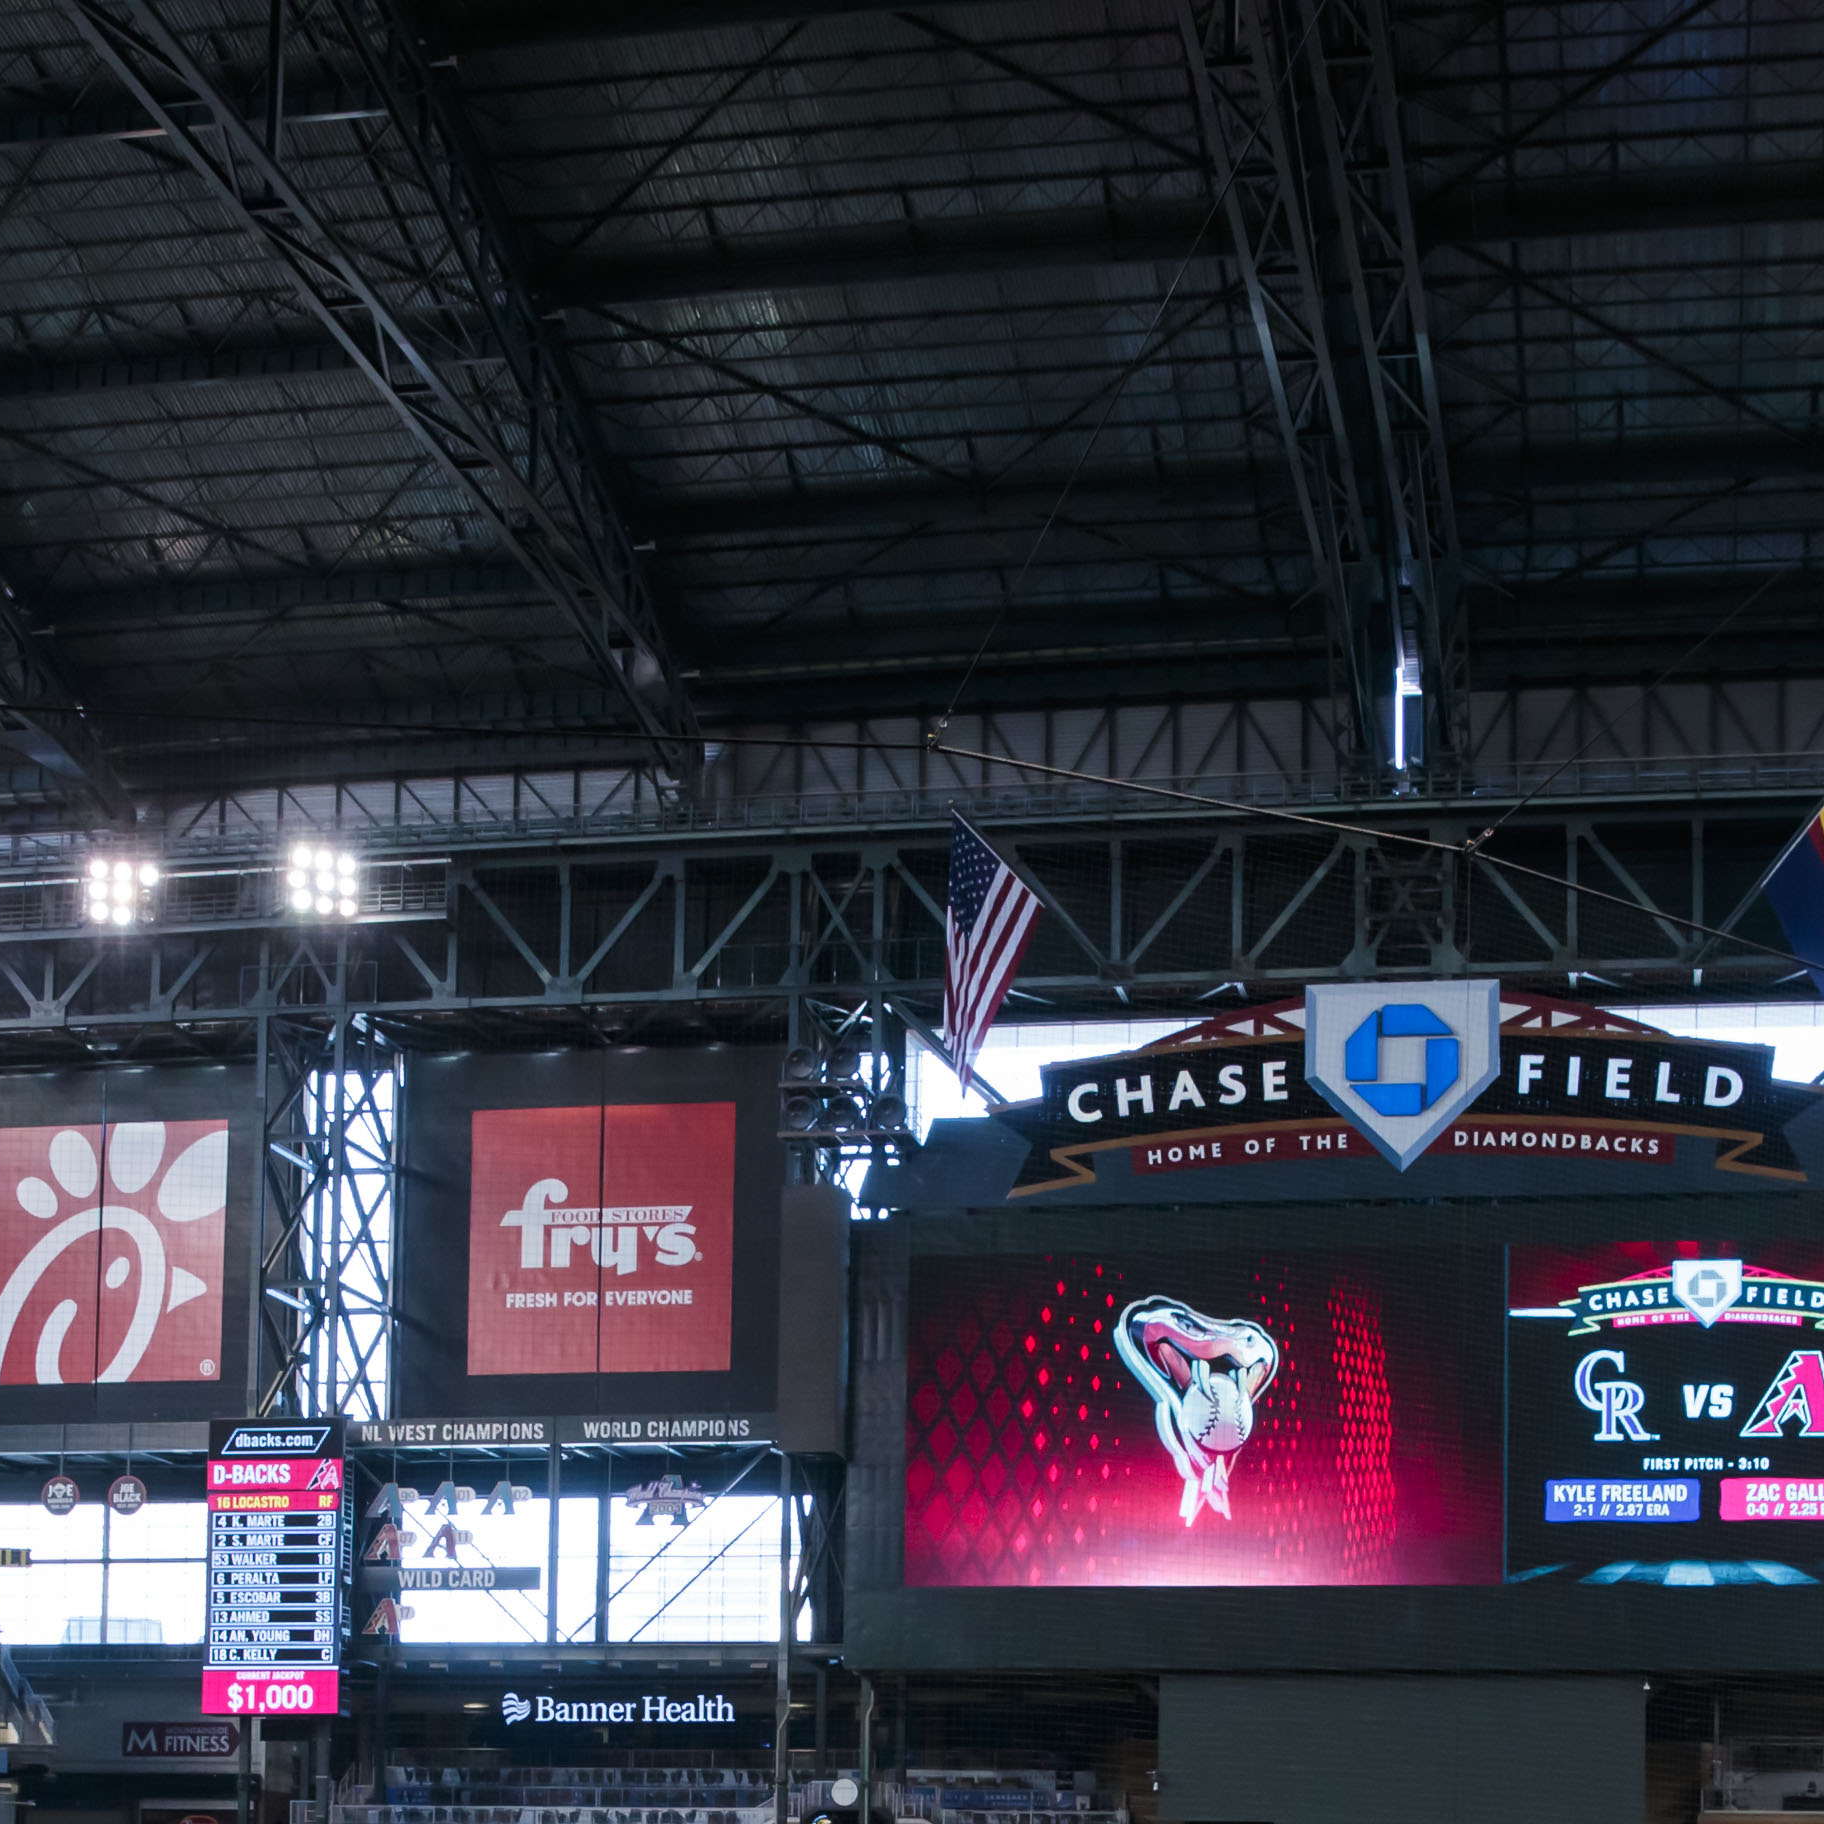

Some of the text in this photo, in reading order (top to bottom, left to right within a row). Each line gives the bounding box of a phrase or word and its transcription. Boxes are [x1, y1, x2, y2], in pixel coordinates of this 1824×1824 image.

[1066, 1053, 1746, 1126] CHASE FIELD
[1146, 1129, 1662, 1166] HOME OF THE DIAMONDBACKS
[611, 1208, 684, 1222] STORES
[500, 1178, 697, 1276] fry's
[506, 1289, 693, 1309] FRESH FOR EVERYONE
[1588, 1290, 1670, 1311] CHASE
[1682, 1384, 1734, 1419] VS
[362, 1423, 544, 1442] NL WEST CHAMPIONS
[583, 1419, 751, 1438] WORLD CHAMPIONS
[1642, 1457, 1770, 1471] FIRST PITCH 3:10
[213, 1463, 291, 1485] D-BACKS
[1553, 1484, 1688, 1502] KYLE FREELAND
[1746, 1484, 1781, 1501] ZAC
[232, 1496, 290, 1508] LOCASTRO
[1646, 1503, 1670, 1516] ERA
[246, 1515, 285, 1528] MARTE
[246, 1534, 285, 1547] MARTE
[231, 1553, 277, 1566] WALKER
[231, 1572, 280, 1585] PERALTA
[398, 1569, 496, 1588] WILD CARD
[230, 1592, 281, 1604] ESCOBAR
[229, 1611, 270, 1622] AHMED
[252, 1630, 290, 1641] YOUNG
[243, 1649, 278, 1661] KELLY
[227, 1683, 314, 1713] $1,000
[536, 1694, 736, 1722] Banner Health
[164, 1734, 230, 1754] FITNESS
